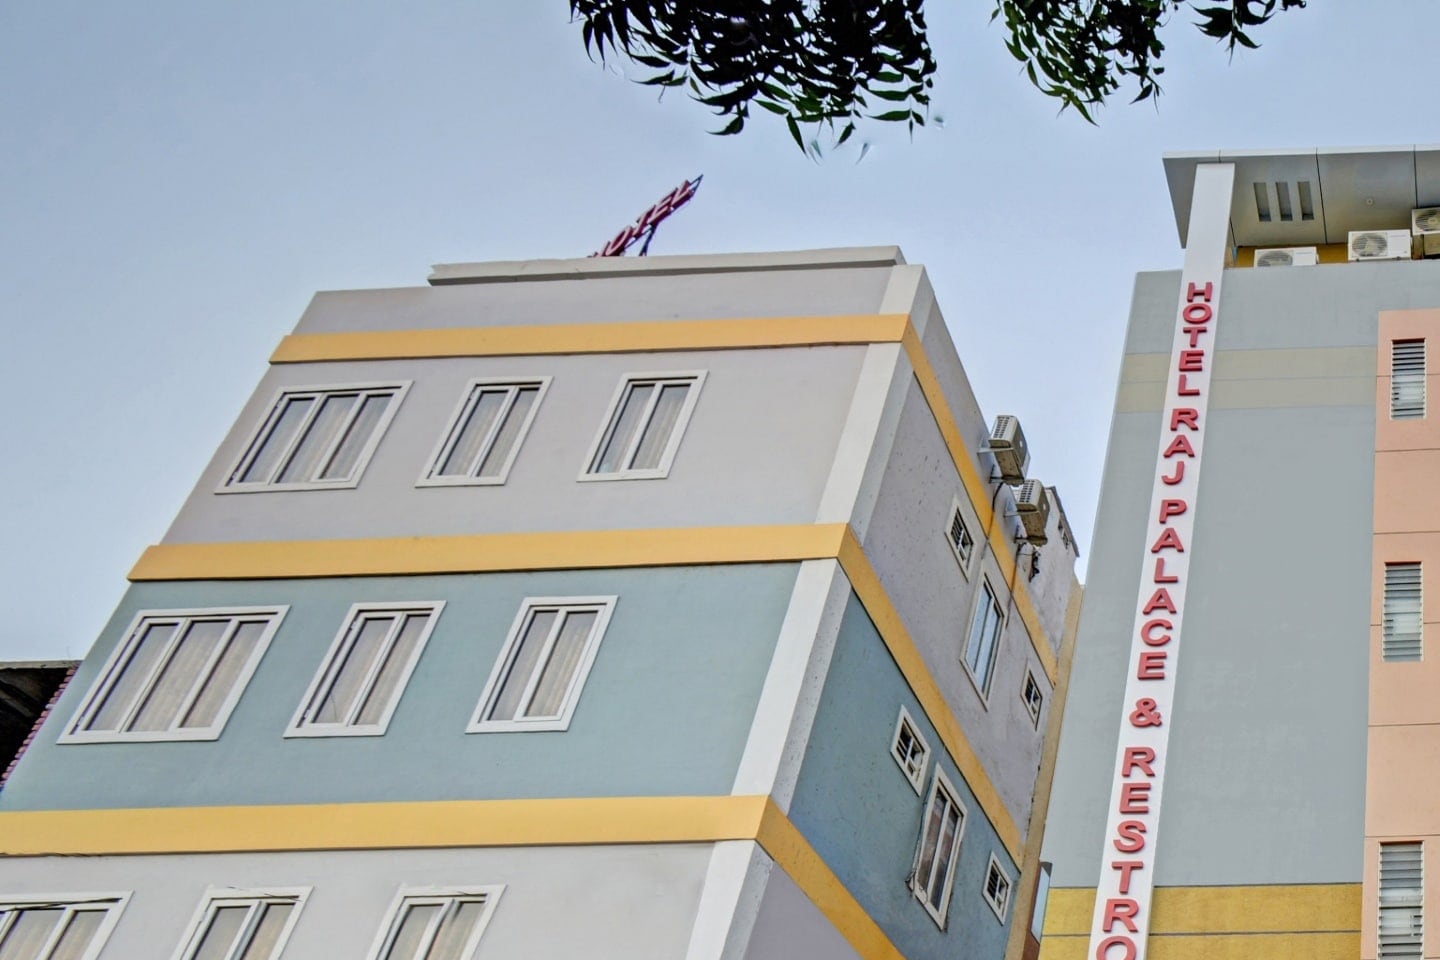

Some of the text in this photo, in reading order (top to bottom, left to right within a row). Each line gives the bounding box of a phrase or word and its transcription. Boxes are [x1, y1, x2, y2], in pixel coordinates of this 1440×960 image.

[1178, 281, 1213, 396] HOTEL
[1161, 408, 1199, 486] RAJ
[1137, 499, 1187, 680] PALACE
[1129, 697, 1162, 728] &
